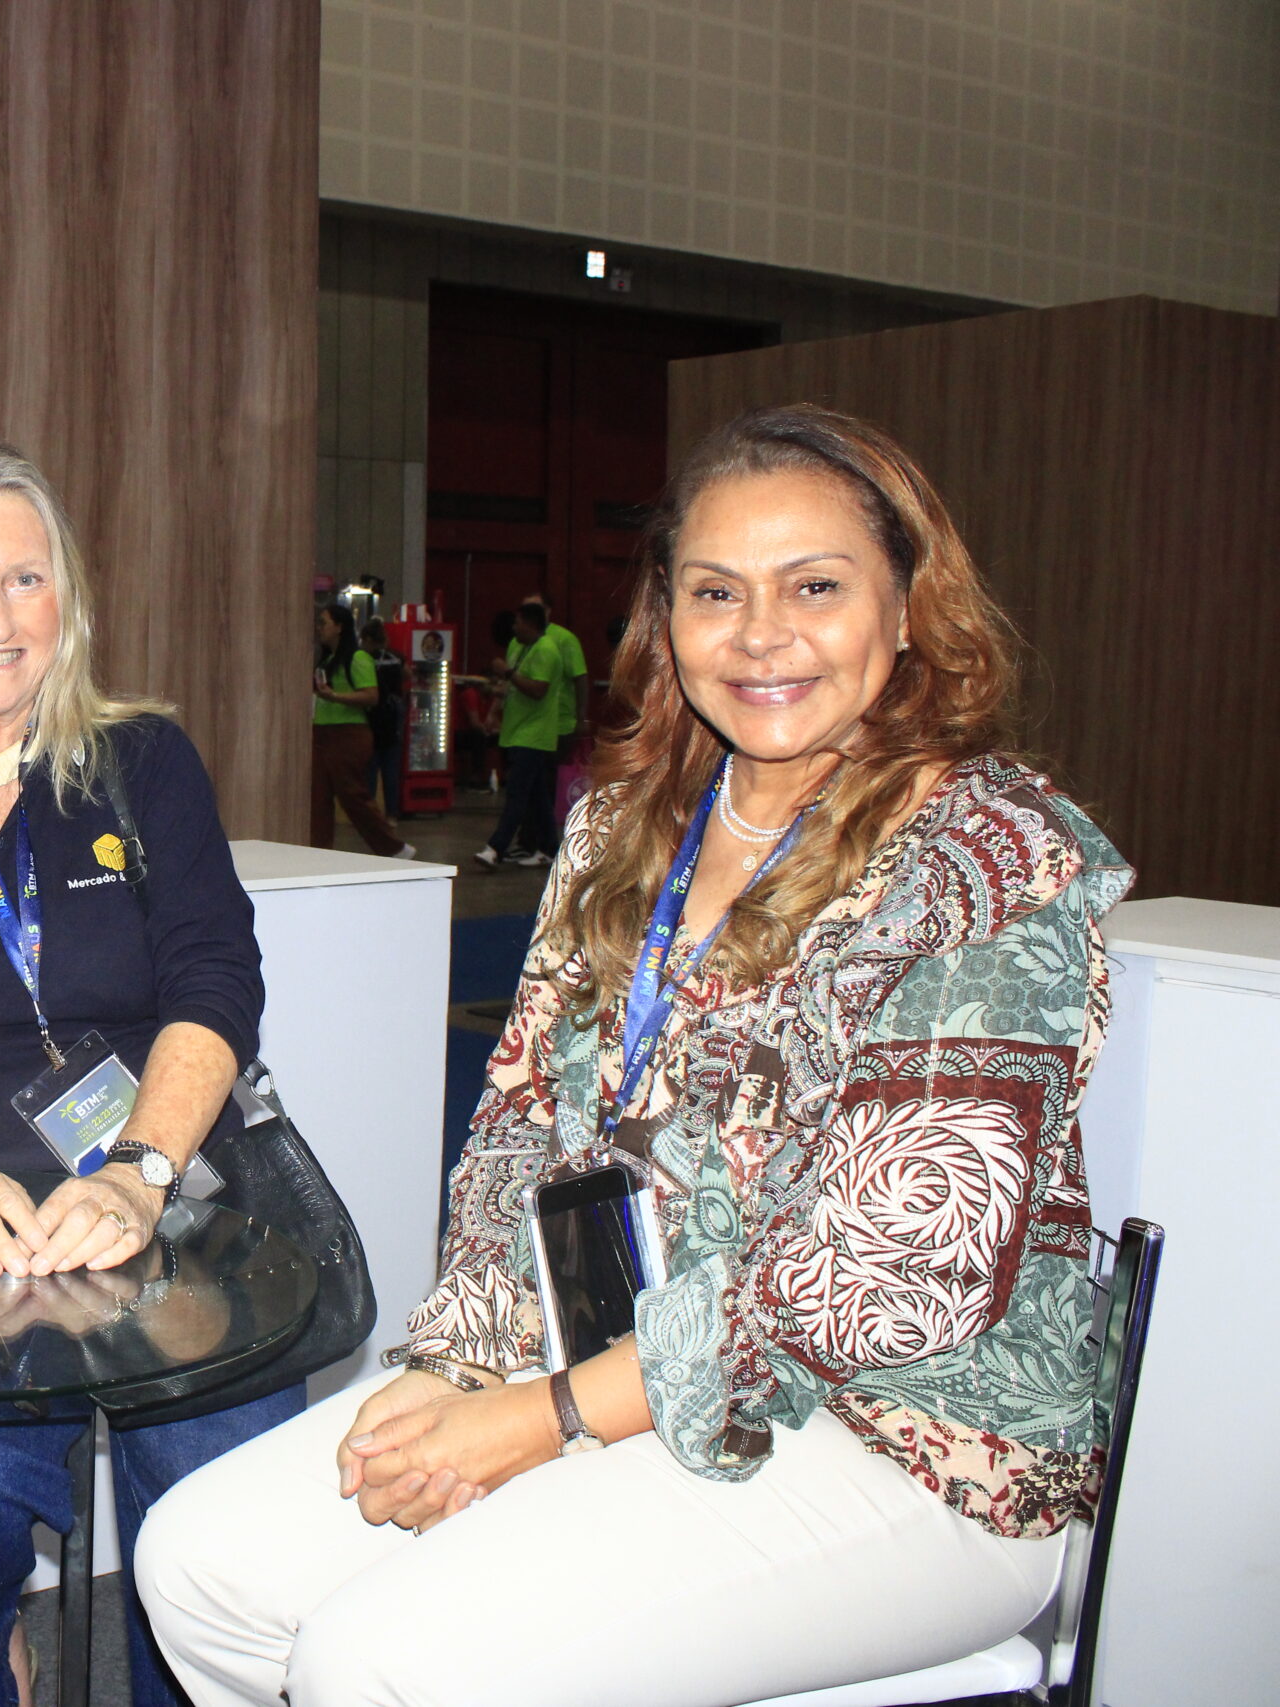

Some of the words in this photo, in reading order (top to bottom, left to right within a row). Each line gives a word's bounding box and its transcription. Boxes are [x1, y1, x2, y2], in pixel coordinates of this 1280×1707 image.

[67, 872, 117, 889] Mercado
[678, 866, 691, 889] BTM
[639, 923, 670, 997] MANAUS
[631, 1042, 646, 1065] BTM
[75, 1093, 100, 1117] BTM
